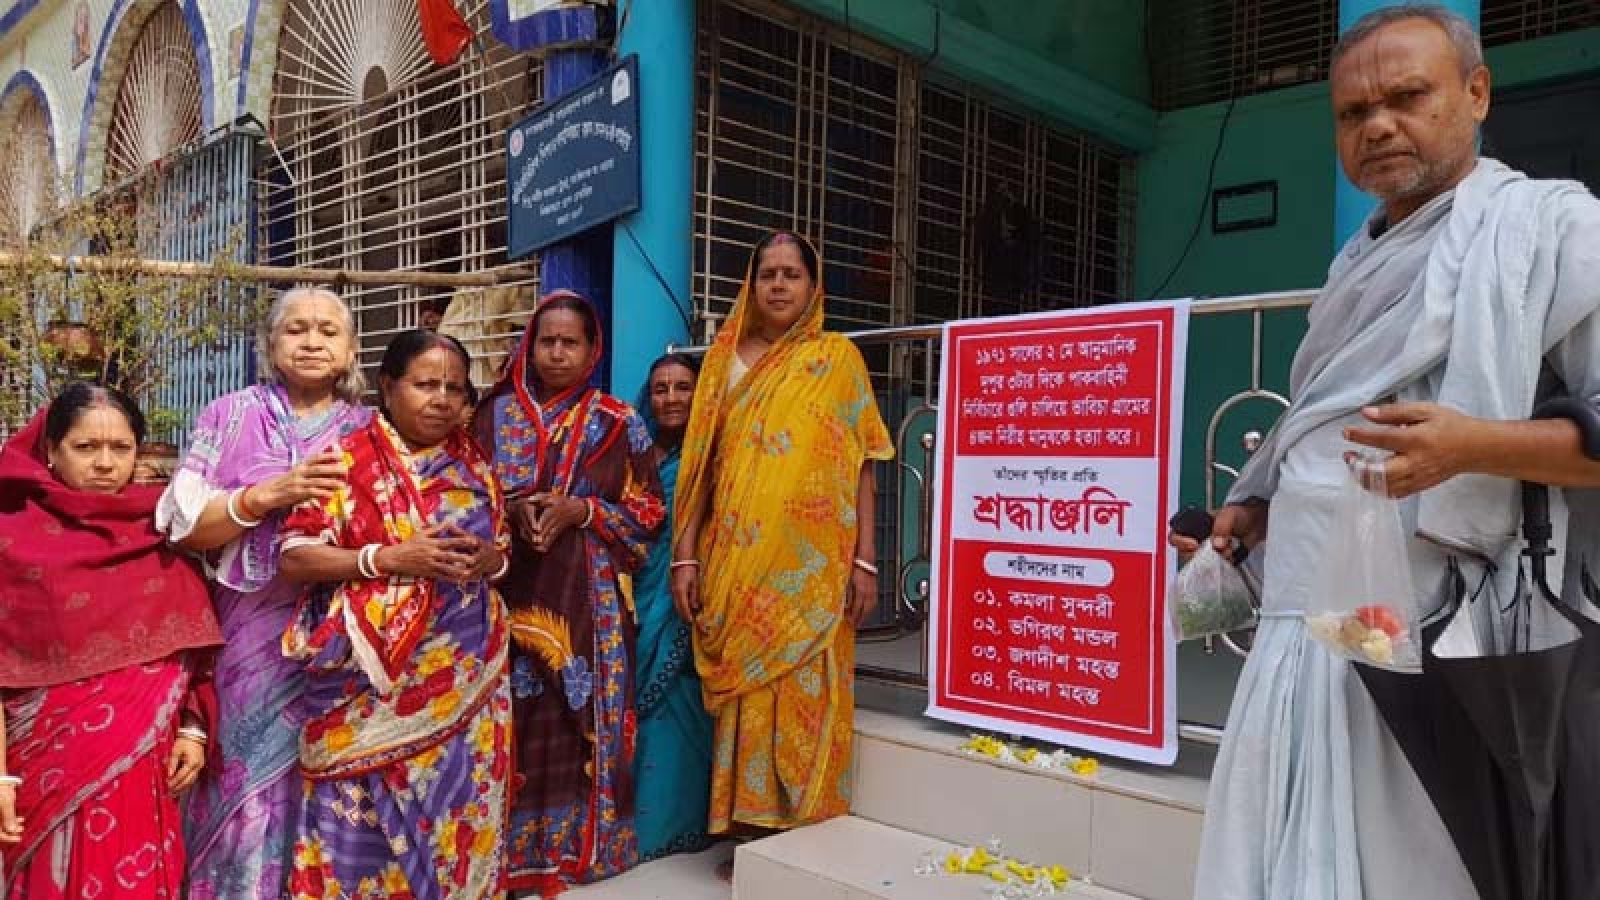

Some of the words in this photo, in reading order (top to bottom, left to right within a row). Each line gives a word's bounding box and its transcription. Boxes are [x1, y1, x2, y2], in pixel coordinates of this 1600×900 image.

[976, 348, 1005, 365] ১৯৭১
[1009, 345, 1043, 361] সালের
[1047, 345, 1054, 360] ২
[1060, 344, 1074, 360] মে
[1078, 334, 1137, 361] আনুমানিক
[980, 374, 1005, 394] দুপুর
[1008, 371, 1035, 390] ৩টার
[1038, 368, 1065, 388] দিকে
[1070, 362, 1129, 389] পাকবাহিনী
[963, 398, 1003, 418] নির্বিচারে
[1008, 396, 1028, 416] গুলি
[1032, 395, 1067, 416] চালিয়ে
[1112, 397, 1152, 416] গ্রামের
[1029, 429, 1071, 448] মানুষকে
[1073, 429, 1102, 446] হত্যা
[1106, 429, 1133, 446] করে
[993, 466, 1029, 481] তাঁদের
[1033, 466, 1068, 485] স্মৃতির
[1072, 467, 1101, 482] প্রতি
[973, 486, 1133, 537] শ্রদ্ধাঞ্জলি
[1007, 555, 1059, 577] শহীদদের
[1061, 563, 1087, 579] নাম
[973, 588, 1002, 608] ০১.
[1008, 590, 1055, 613] কমলা
[1060, 593, 1116, 620] সুন্দরী
[973, 616, 1002, 635] ০২.
[1008, 615, 1066, 642] ভগিরথ
[1072, 627, 1120, 649] মন্ডল
[972, 645, 1002, 663] ০৩.
[1008, 645, 1071, 673] জগদীশ
[971, 671, 1001, 691] ০৪.
[1008, 669, 1052, 700] বিমল
